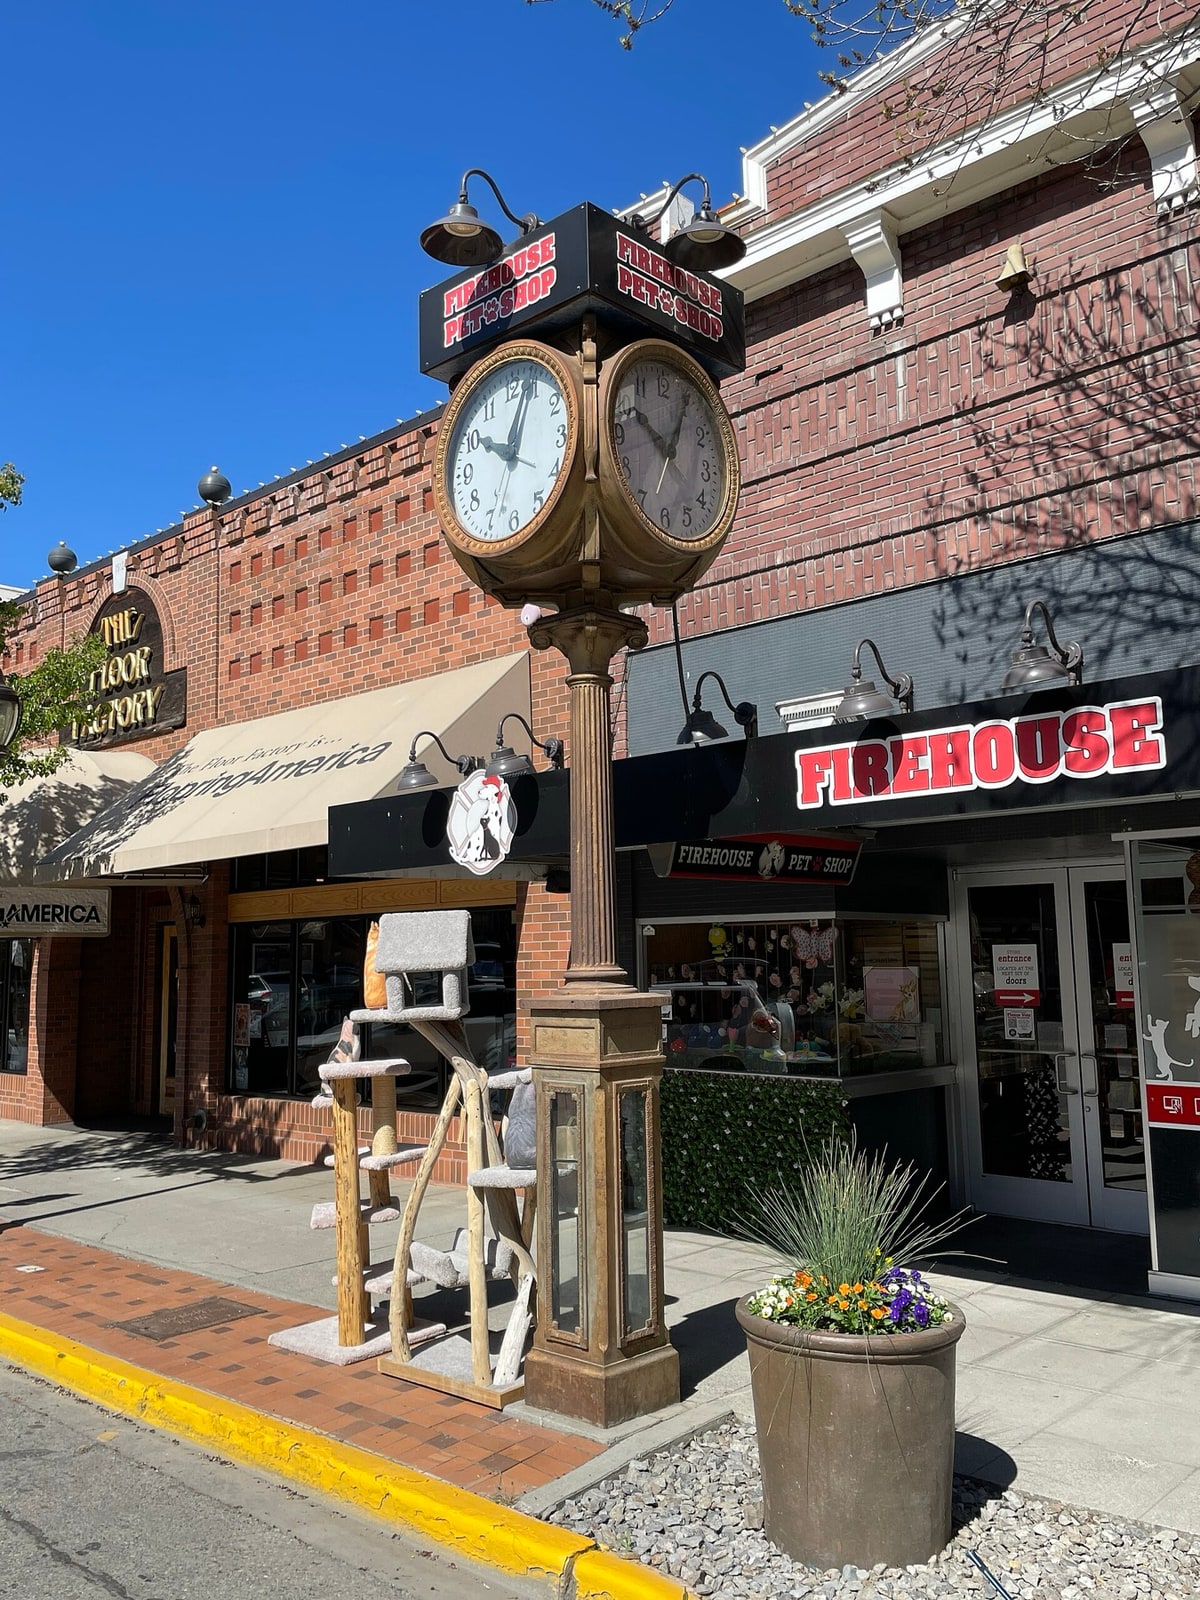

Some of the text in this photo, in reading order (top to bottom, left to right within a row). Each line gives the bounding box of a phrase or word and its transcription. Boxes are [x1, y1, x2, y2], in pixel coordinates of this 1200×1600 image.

[444, 232, 556, 318] FIREHOUSE
[616, 231, 722, 315] FIREHOUSE
[444, 266, 557, 348] PET SHOP
[617, 263, 723, 342] PET SHOP
[504, 377, 520, 403] 12
[636, 377, 646, 399] 11
[657, 376, 670, 399] 12
[483, 397, 496, 423] 11
[549, 393, 563, 417] 2
[466, 429, 480, 455] 10
[556, 424, 567, 448] 3
[615, 422, 625, 446] 9
[695, 427, 705, 448] 2
[463, 463, 474, 485] 9
[548, 457, 560, 482] 4
[622, 456, 632, 479] 8
[700, 460, 711, 483] 3
[470, 489, 480, 512] 8
[533, 489, 544, 514] 5
[638, 489, 648, 509] 7
[696, 489, 707, 510] 4
[486, 508, 496, 531] 7
[508, 510, 520, 532] 6
[660, 508, 670, 529] 6
[682, 505, 692, 528] 5
[100, 607, 145, 646] THE
[200, 755, 244, 772] Floor
[244, 742, 307, 762] Factory
[795, 696, 1167, 810] FIREHOUSE
[678, 845, 754, 867] FIREHOUSE
[788, 854, 853, 874] PET SHOP
[998, 954, 1032, 962] entrance
[1005, 976, 1027, 985] doors
